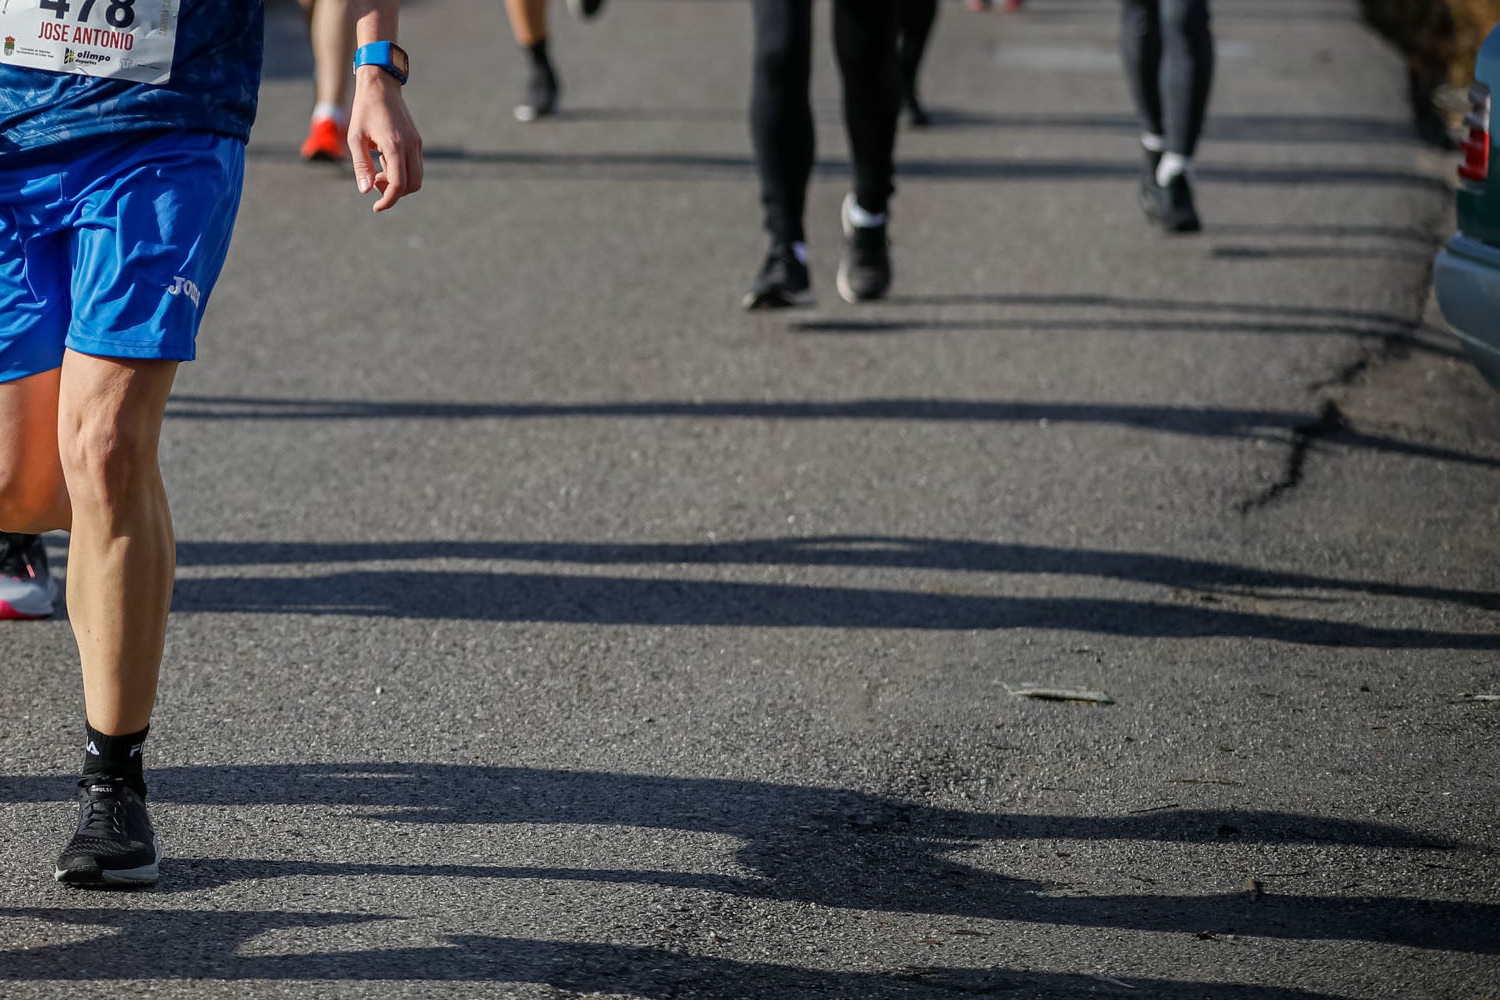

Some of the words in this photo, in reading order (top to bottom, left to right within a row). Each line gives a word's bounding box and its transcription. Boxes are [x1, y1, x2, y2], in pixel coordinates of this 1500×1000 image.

[38, 22, 70, 42] JOSE
[73, 26, 134, 51] ANTONIO
[77, 50, 111, 63] olimpo
